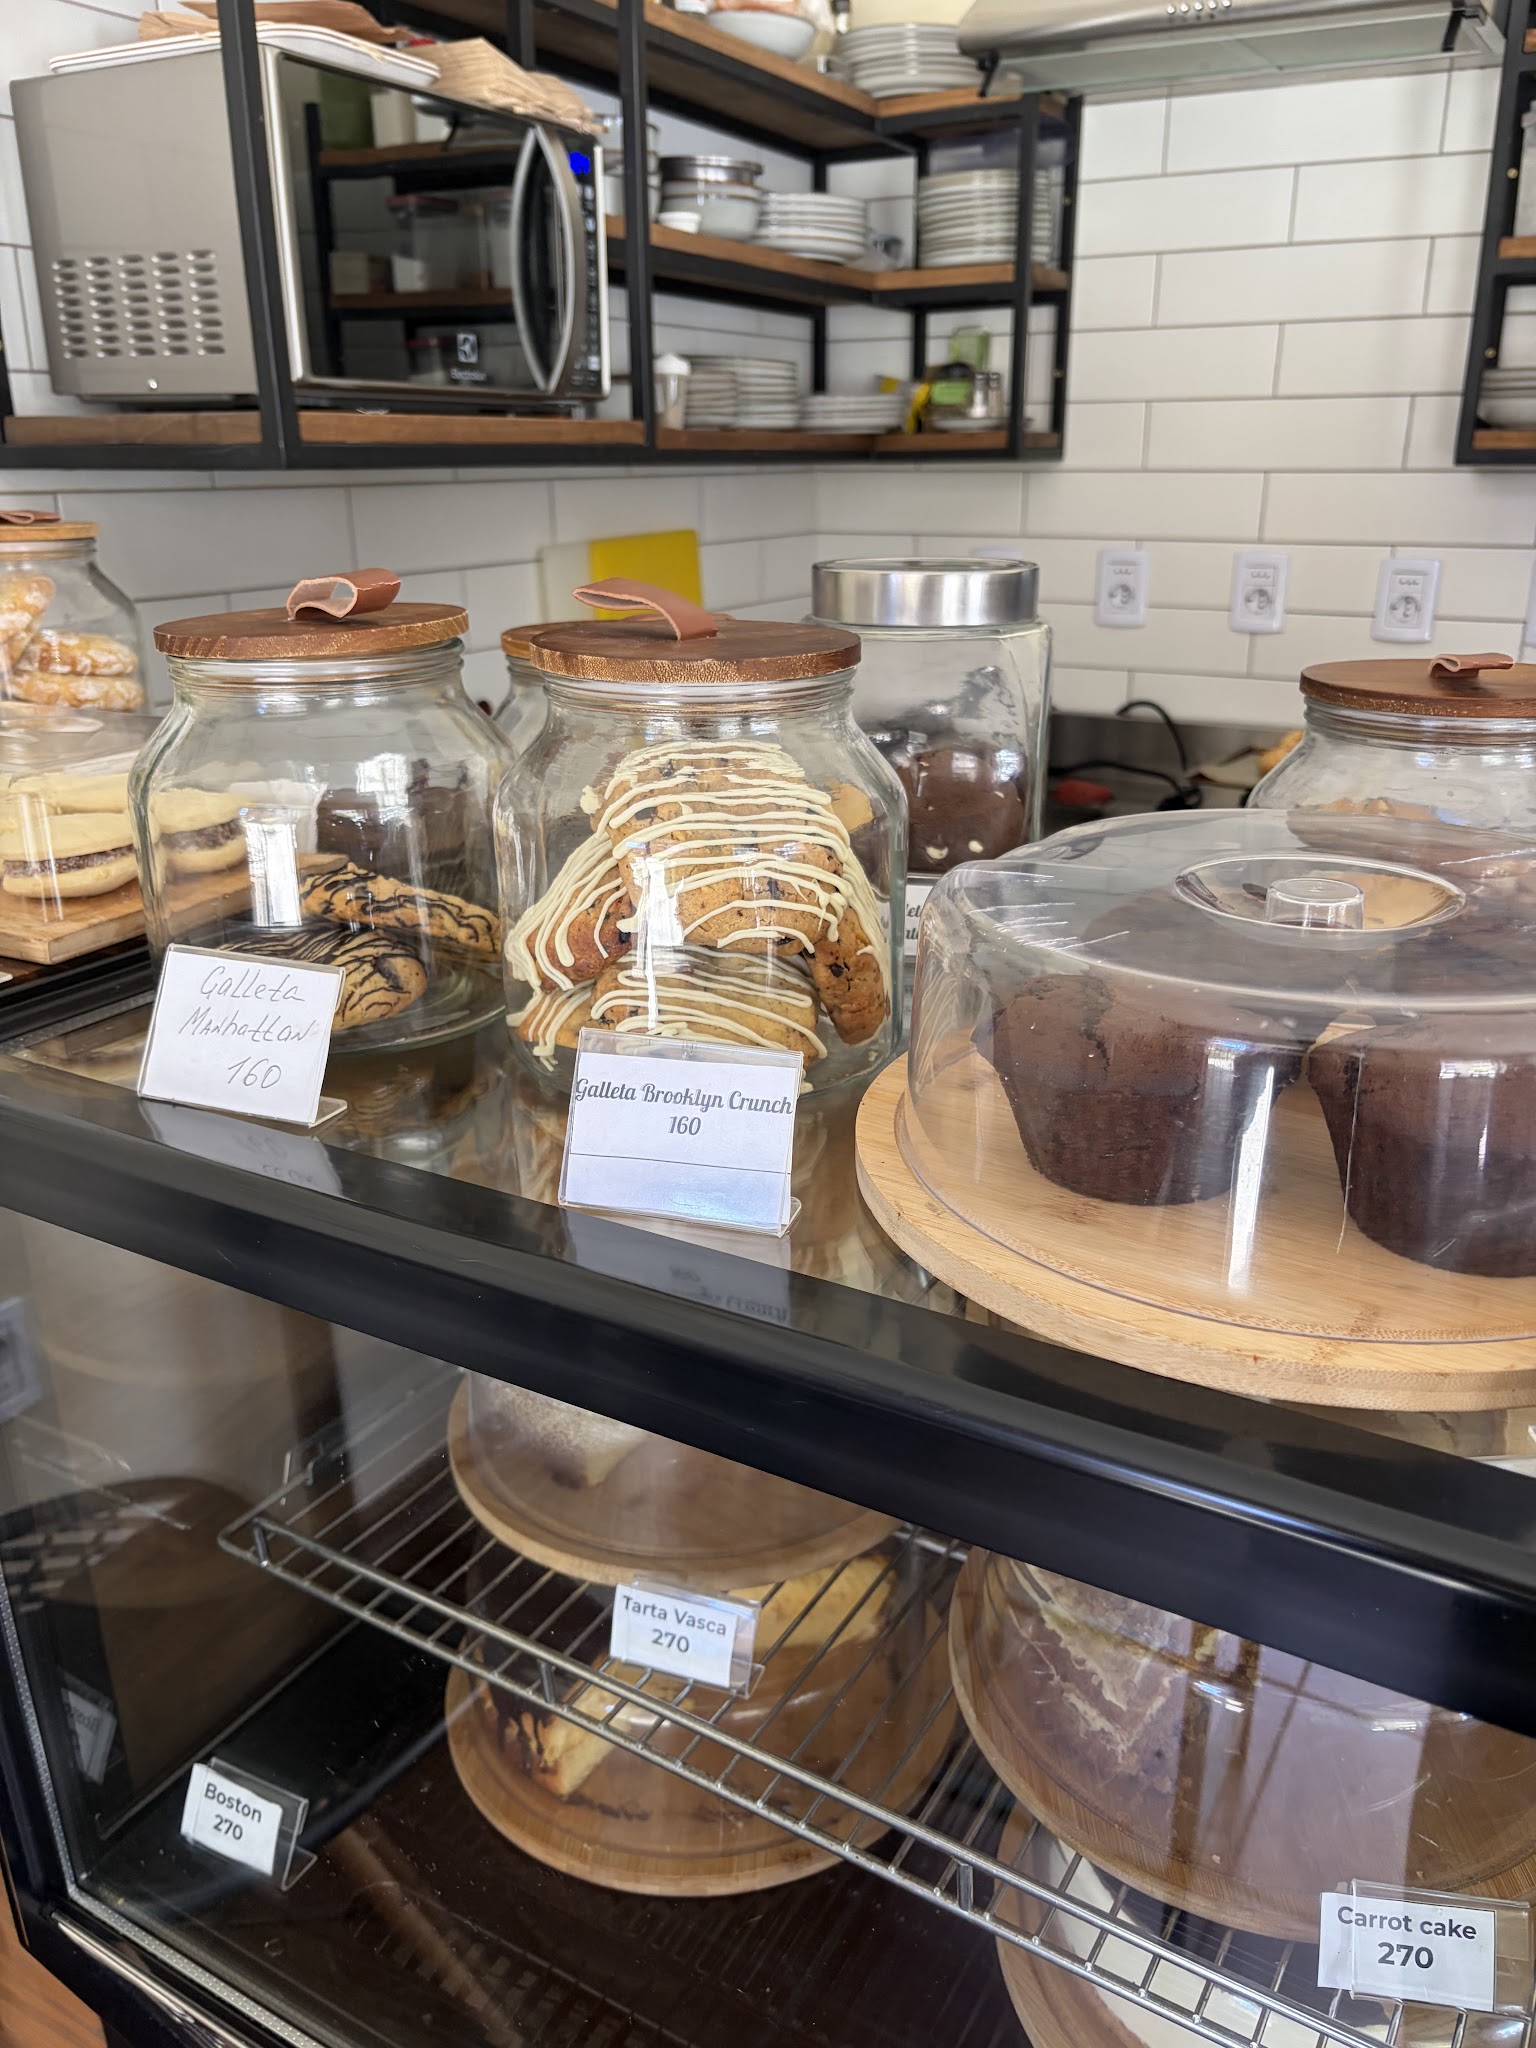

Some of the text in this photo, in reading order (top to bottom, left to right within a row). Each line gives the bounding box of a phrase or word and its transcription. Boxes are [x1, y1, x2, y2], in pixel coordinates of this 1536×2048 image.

[201, 966, 305, 1001] Galleta
[228, 1056, 282, 1089] 160
[575, 1078, 793, 1115] Galleta Brooklyn Crunch
[668, 1115, 702, 1136] 160
[622, 1595, 727, 1636] Tarta Vasca
[651, 1628, 690, 1653] 270
[204, 1782, 262, 1824] Boston
[213, 1814, 243, 1840] 270
[1337, 1906, 1477, 1940] Carrot cake
[1377, 1942, 1434, 1969] 270
